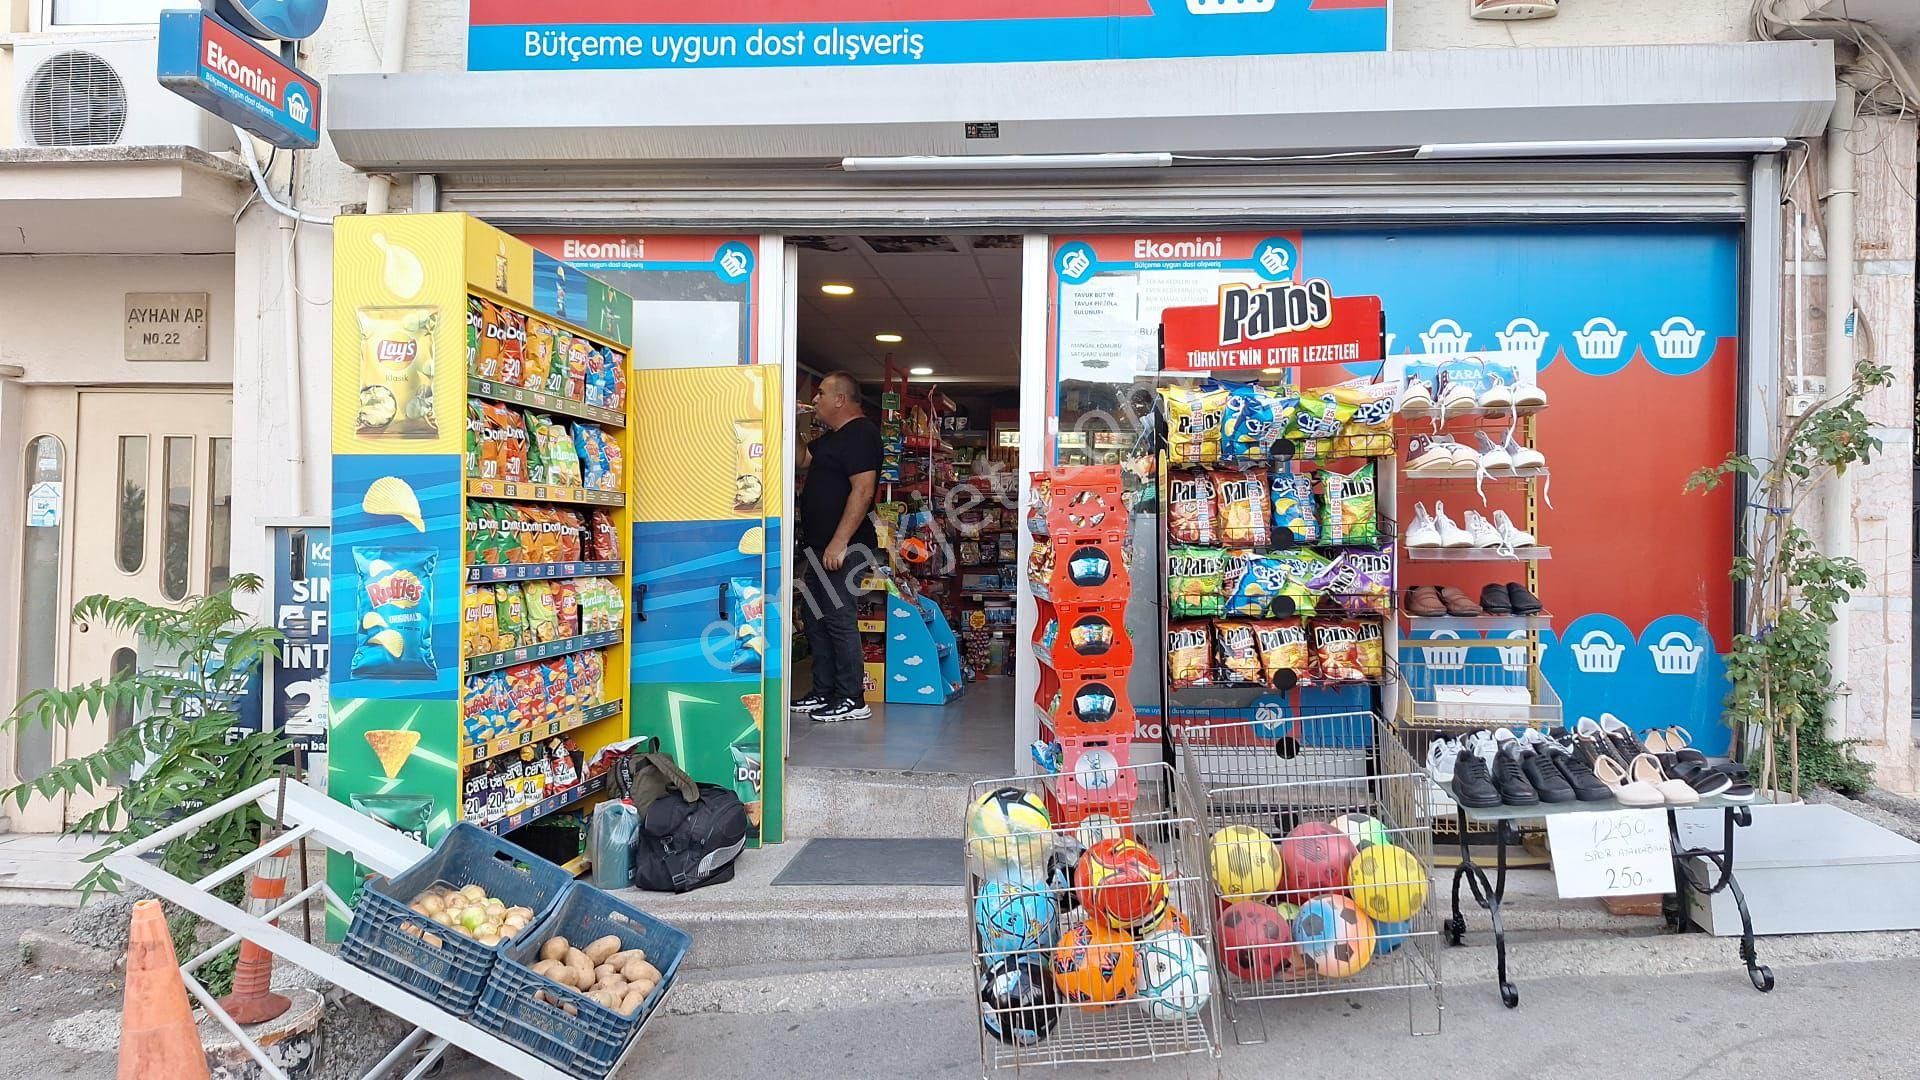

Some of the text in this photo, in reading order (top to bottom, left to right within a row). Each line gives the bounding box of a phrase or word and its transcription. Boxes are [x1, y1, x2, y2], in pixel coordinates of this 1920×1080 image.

[525, 26, 924, 62] Bütçeme uygun dost alışveriş
[207, 40, 277, 102] Ekomini
[563, 239, 645, 258] Ekomini
[1134, 237, 1222, 259] Ekomini
[1135, 261, 1162, 269] Bütçeme
[128, 308, 180, 323] AYHAN
[143, 333, 181, 345] NO.22
[1187, 340, 1360, 369] TÜRKİYE'NİN ÇITIR LEZZETLERİ
[1326, 409, 1335, 417] 25
[490, 792, 502, 808] 20
